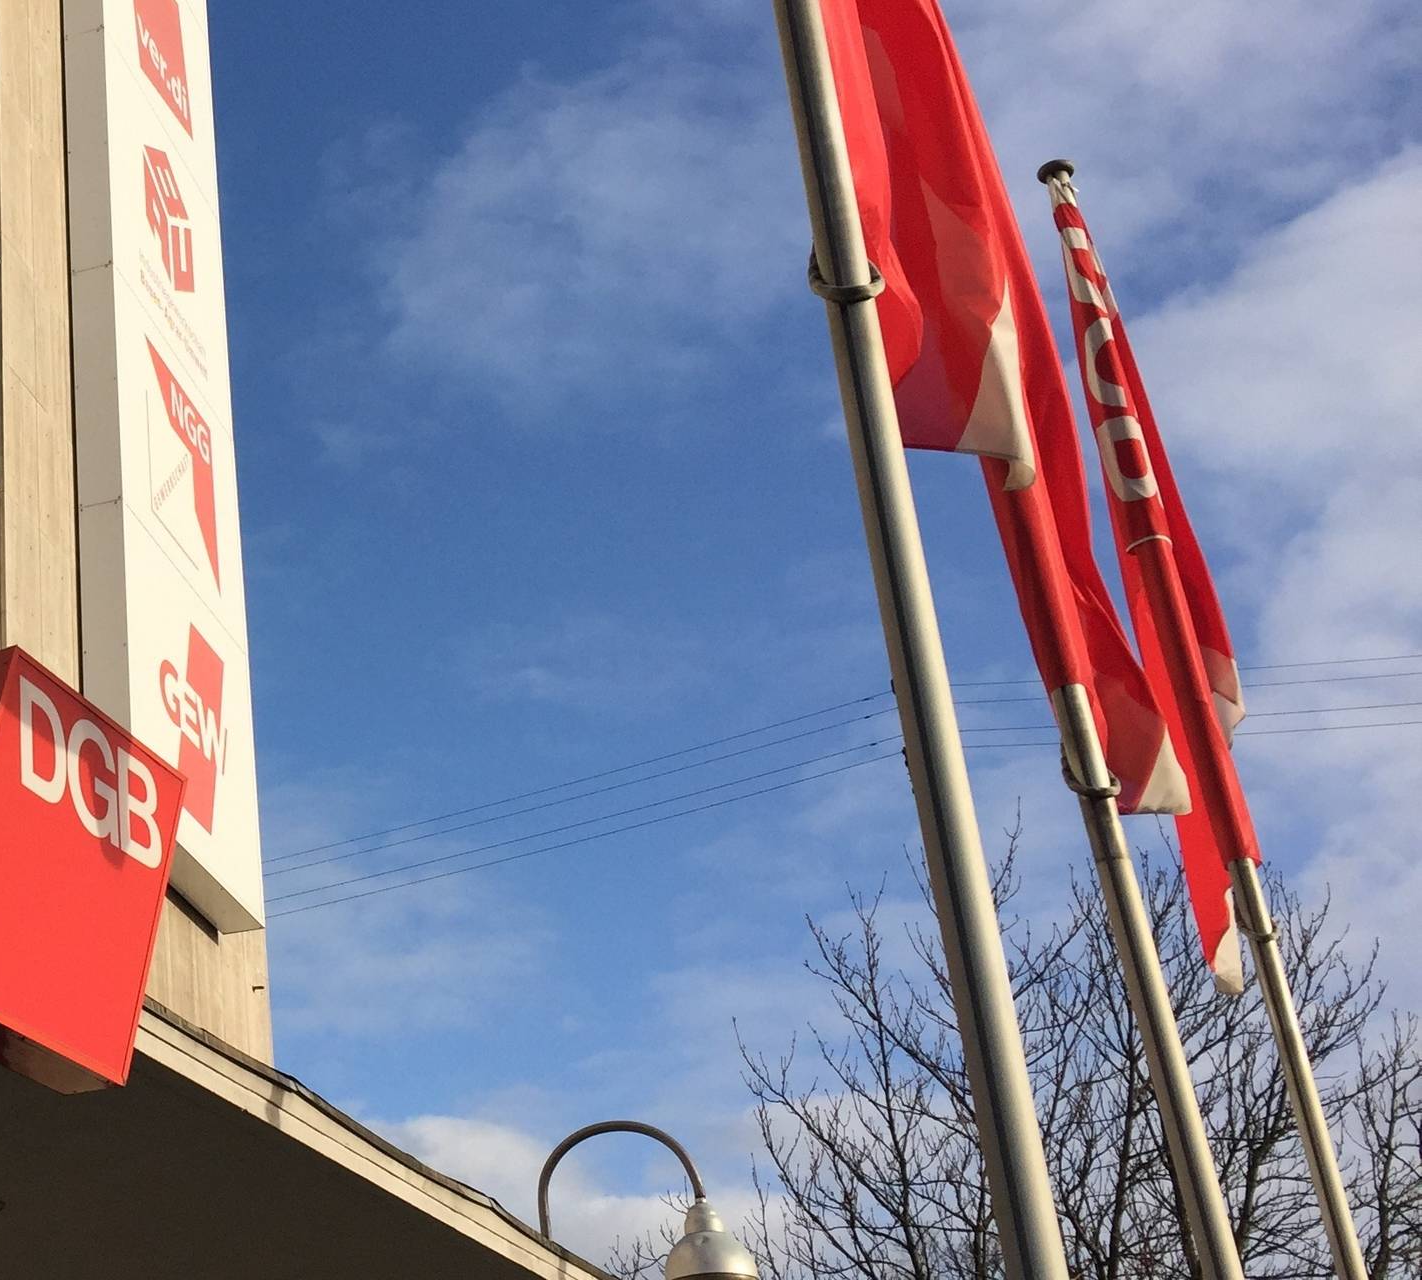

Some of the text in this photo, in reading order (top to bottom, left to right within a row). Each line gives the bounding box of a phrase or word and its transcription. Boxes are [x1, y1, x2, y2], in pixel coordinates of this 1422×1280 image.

[136, 12, 189, 121] ver.di
[169, 380, 210, 465] NGG
[19, 674, 162, 869] DGB
[159, 659, 227, 776] GEW
